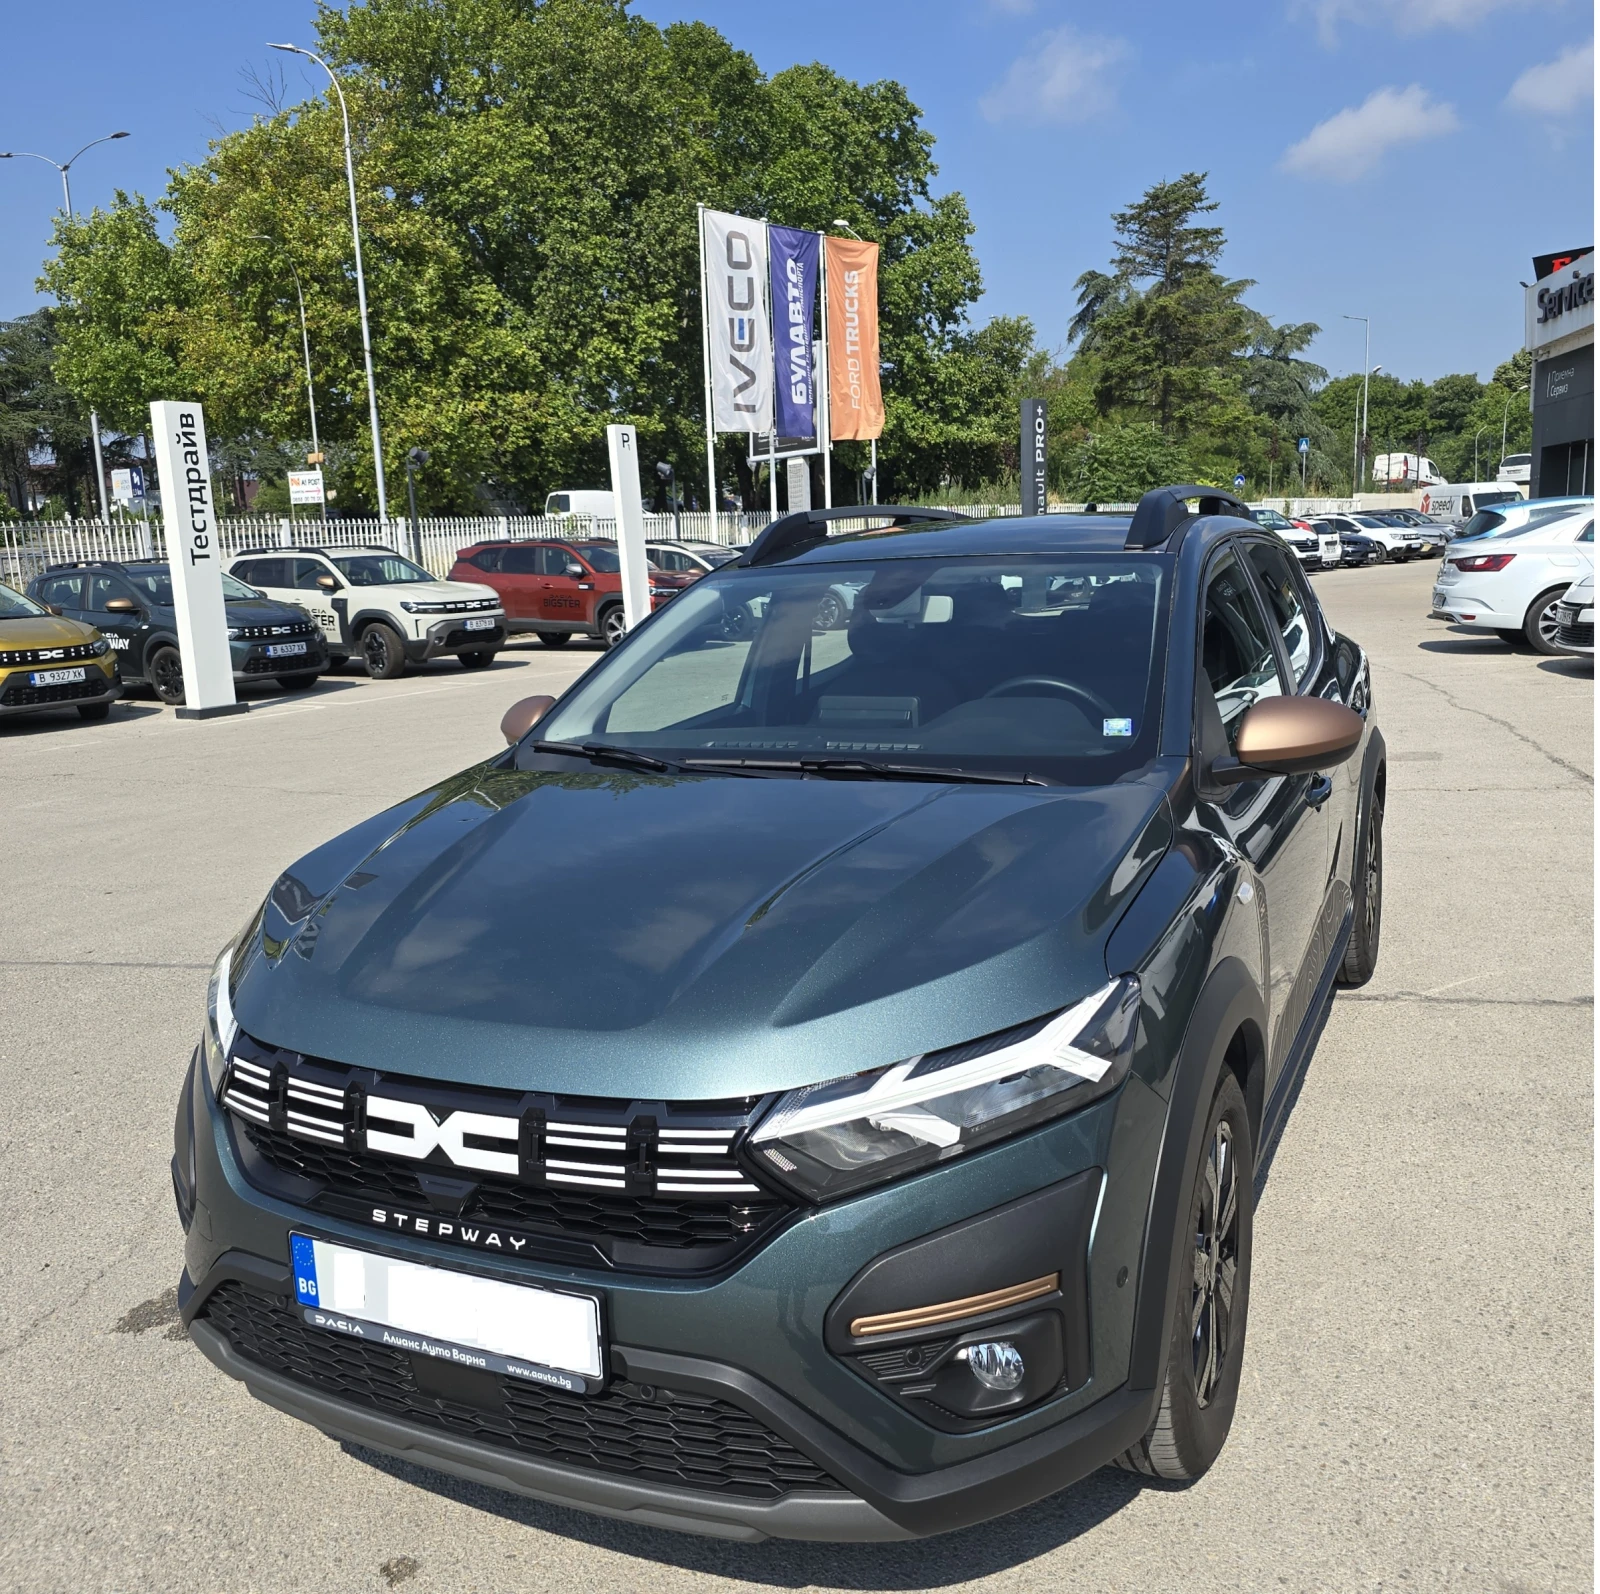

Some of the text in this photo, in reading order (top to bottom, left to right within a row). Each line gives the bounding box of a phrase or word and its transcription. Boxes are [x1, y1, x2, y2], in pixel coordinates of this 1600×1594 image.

[726, 230, 757, 413] IVECO
[786, 258, 807, 405] БУЛАВТО
[844, 270, 861, 409] FORD TRUCKS
[1035, 405, 1045, 462] PRO+
[176, 413, 211, 566] Тестдрайв
[1431, 498, 1456, 517] speedy
[543, 598, 581, 608] BIGSTER
[272, 646, 278, 654] B
[280, 644, 296, 653] 6337
[39, 669, 83, 682] B 9327 XK
[372, 1208, 526, 1251] STEPWAY
[298, 1277, 317, 1296] BG
[315, 1314, 364, 1335] DACIA
[383, 1331, 486, 1367] Алианс Ауто Варна
[506, 1364, 572, 1390] www.aauto.bg
